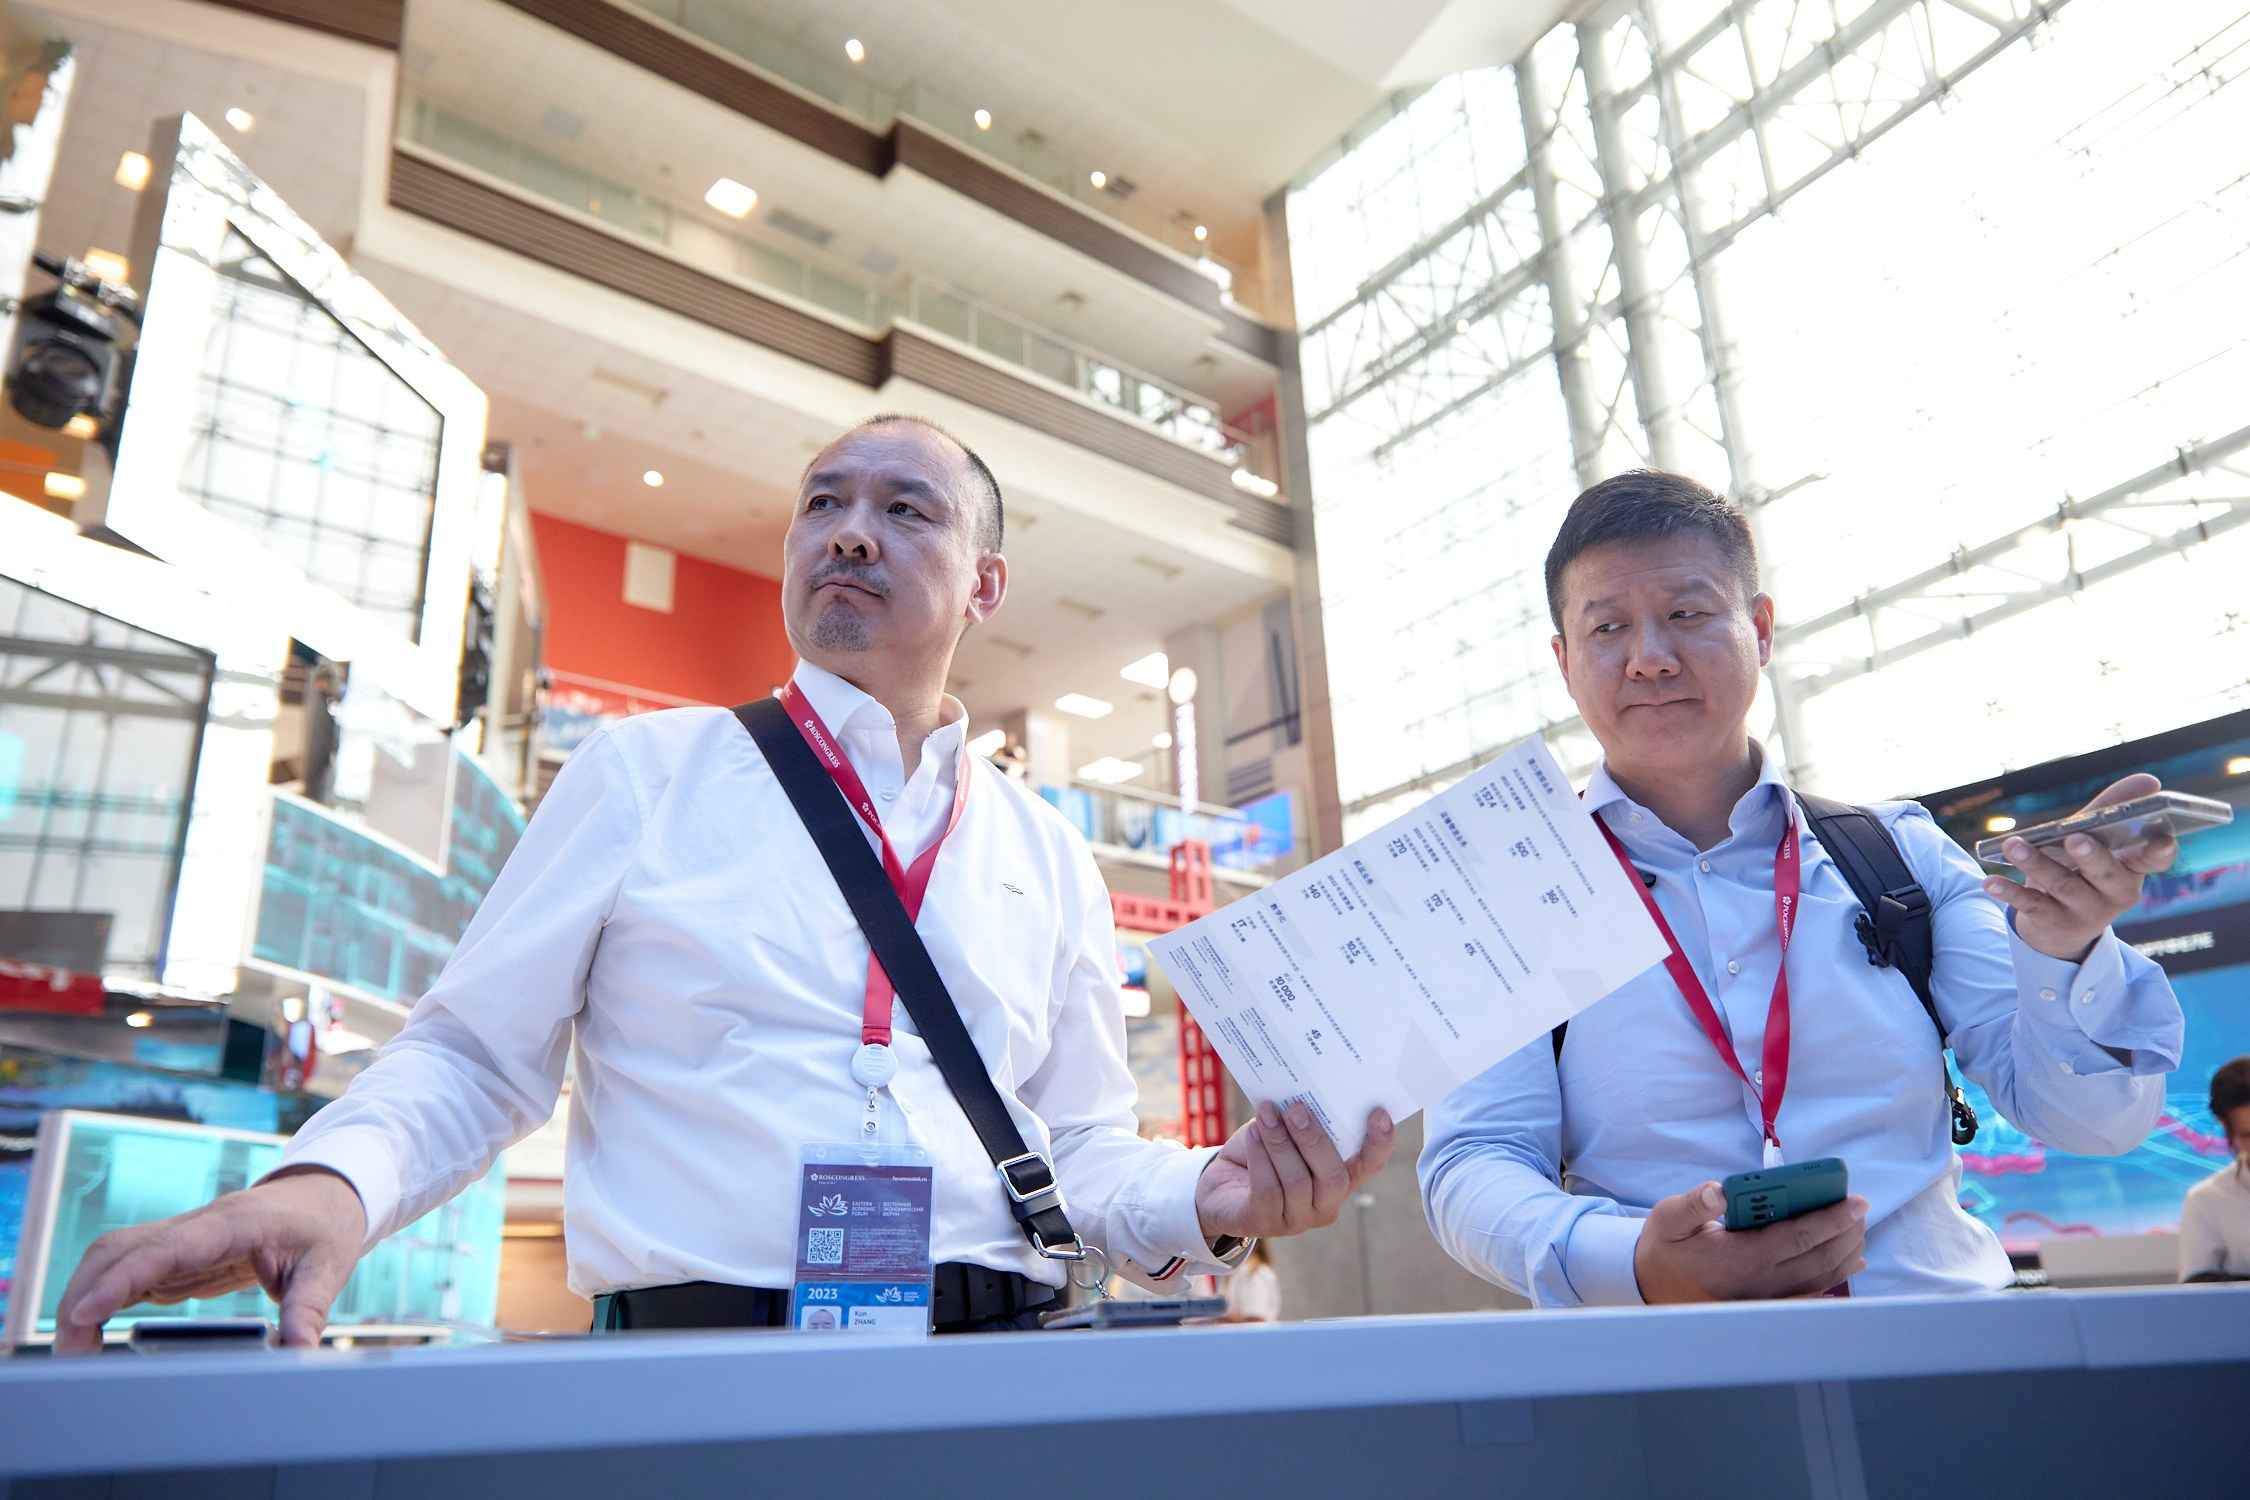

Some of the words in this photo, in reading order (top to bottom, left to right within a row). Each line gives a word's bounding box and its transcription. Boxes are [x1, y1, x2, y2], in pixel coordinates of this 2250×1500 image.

[809, 725, 841, 769] ROSCONGRESS
[1477, 785, 1498, 809] 157.4
[1390, 837, 1408, 855] 270
[1513, 840, 1530, 858] 600
[1305, 883, 1322, 900] 140
[1428, 892, 1444, 908] 170
[1544, 888, 1560, 905] 360
[1268, 902, 1288, 924] 数字化
[1235, 918, 1247, 929] IT
[1344, 939, 1361, 957] 10.5
[1461, 940, 1478, 957] 41%
[1308, 1027, 1322, 1040] 45
[807, 1288, 838, 1300] 2023
[854, 1318, 876, 1326] ZHANG
